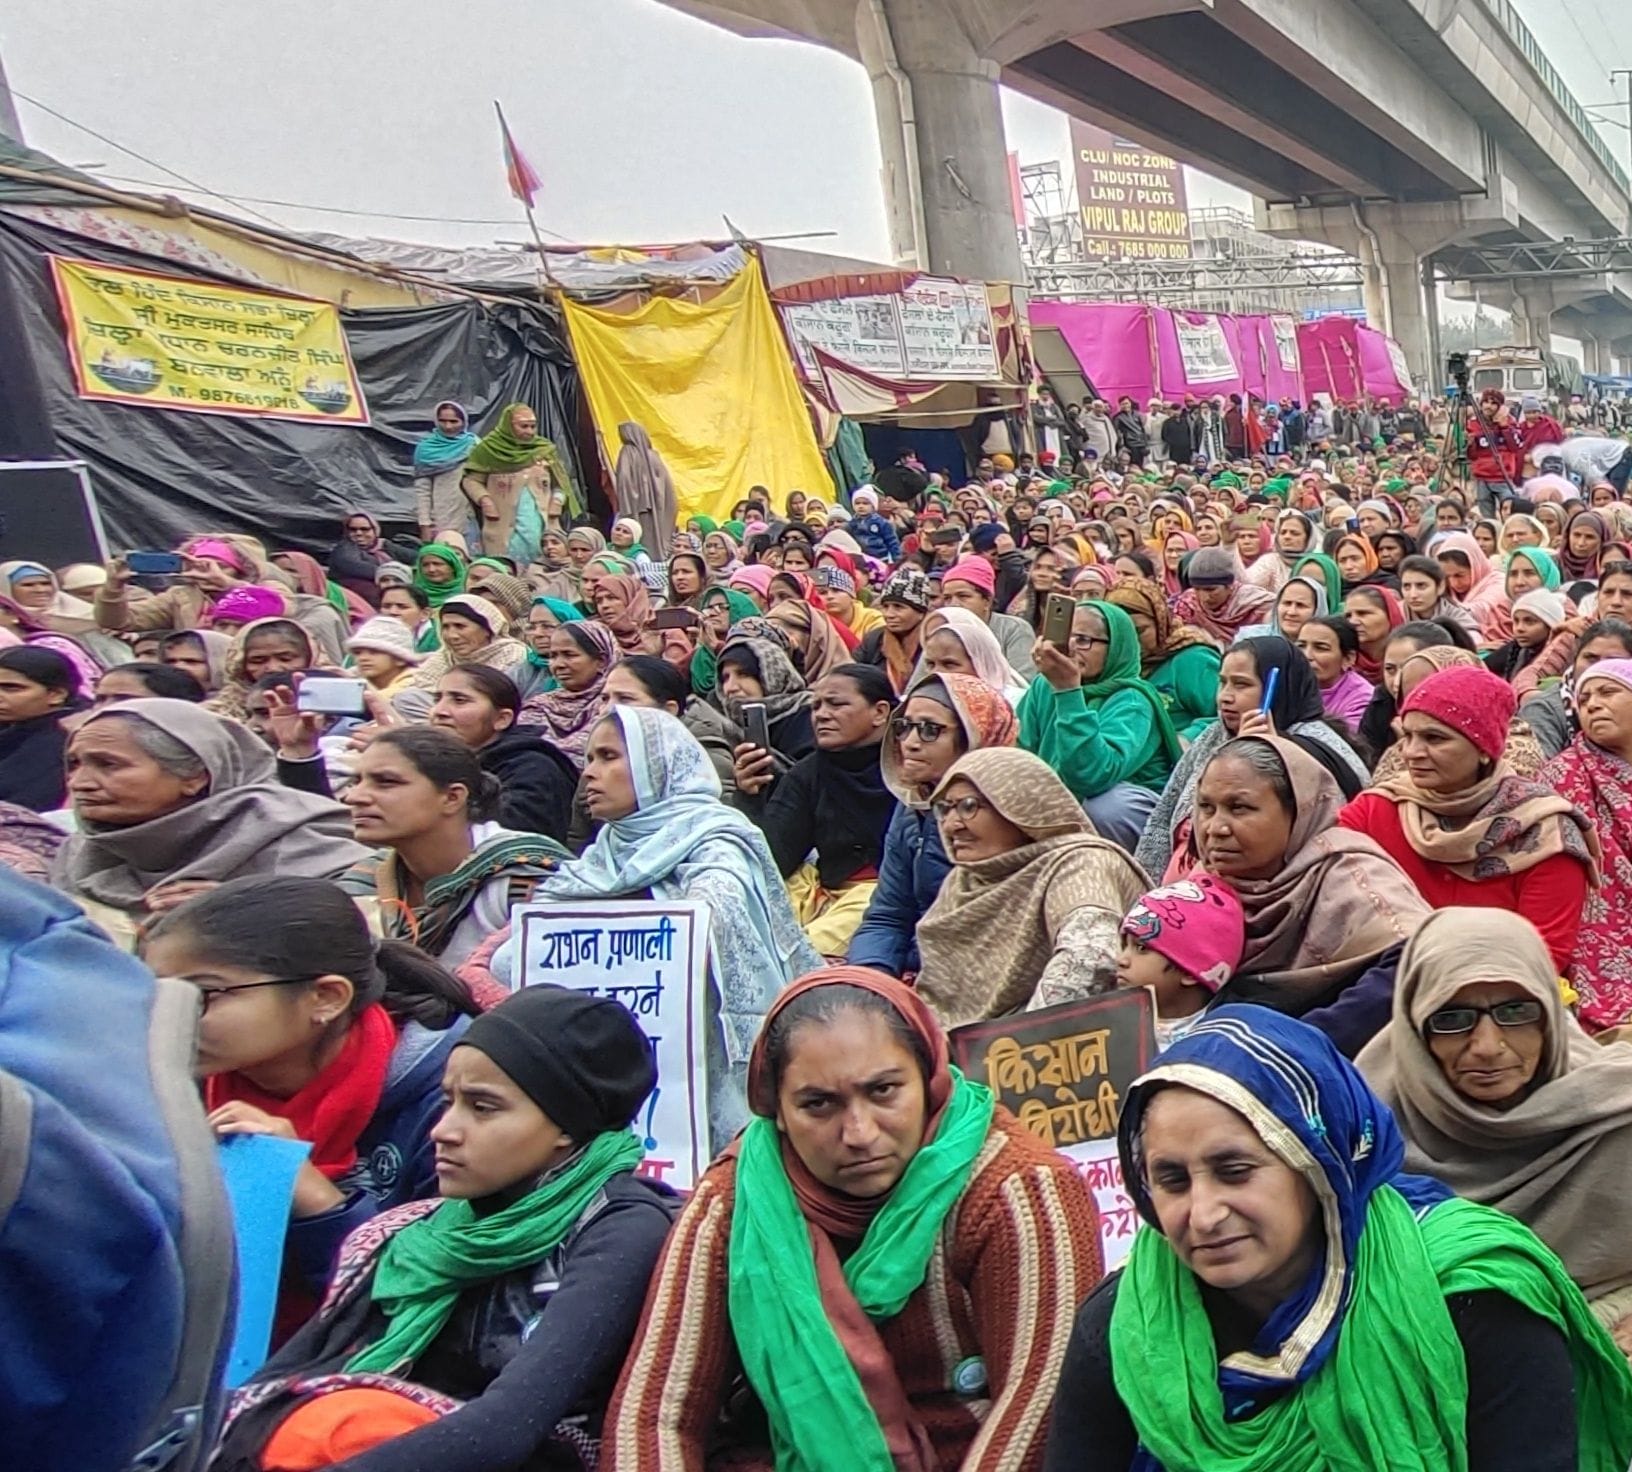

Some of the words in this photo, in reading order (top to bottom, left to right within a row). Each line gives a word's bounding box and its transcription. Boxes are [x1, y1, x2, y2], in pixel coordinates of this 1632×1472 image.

[1113, 152, 1140, 167] NOC
[1142, 154, 1177, 170] ZONE
[1092, 168, 1171, 188] INDUSTRIAL
[1090, 185, 1125, 201] LAND
[1136, 189, 1176, 205] PLOTS
[1082, 205, 1121, 232] VIPUL
[1121, 208, 1146, 234] RAJ
[1147, 209, 1189, 236] GROUP
[1118, 240, 1145, 257] 7685
[1146, 242, 1168, 258] 000
[1168, 243, 1190, 259] 000
[539, 928, 604, 969] राशन
[984, 1028, 1111, 1101] किसान
[1019, 1080, 1120, 1149] विरोधी
